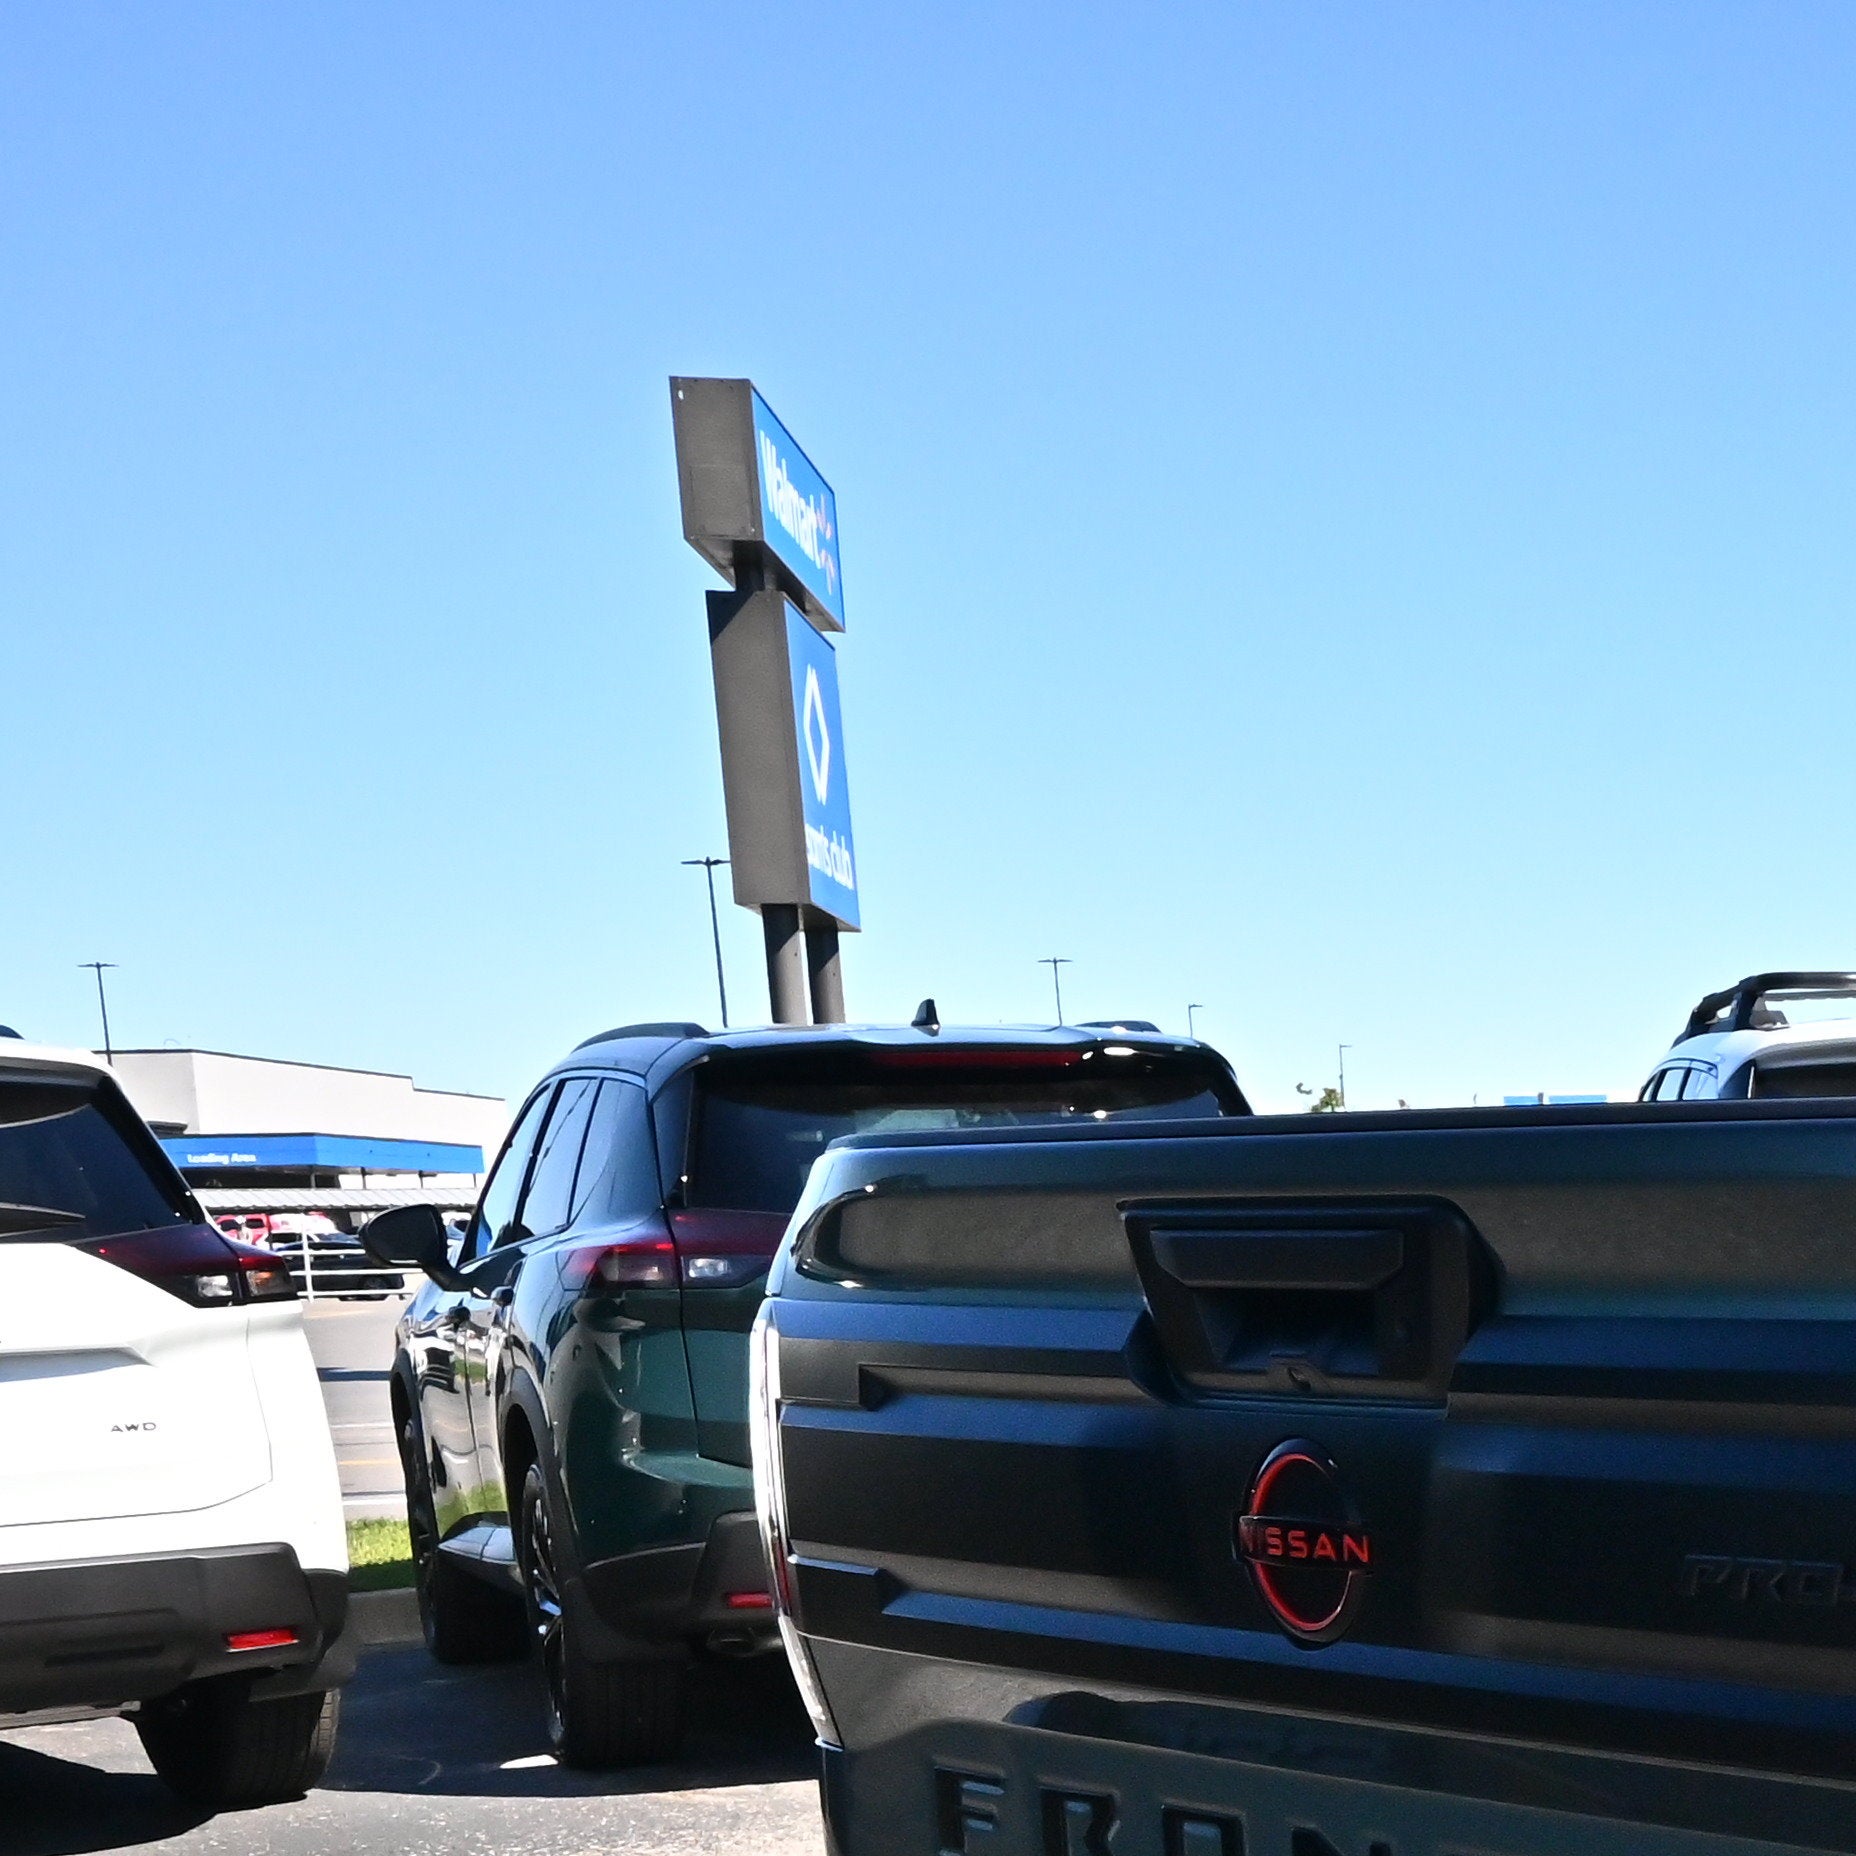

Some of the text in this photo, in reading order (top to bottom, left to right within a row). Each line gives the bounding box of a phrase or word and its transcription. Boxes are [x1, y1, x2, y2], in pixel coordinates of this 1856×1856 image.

[760, 430, 821, 569] Walmart
[187, 1153, 257, 1164] Loading Area
[111, 1422, 156, 1432] AWD
